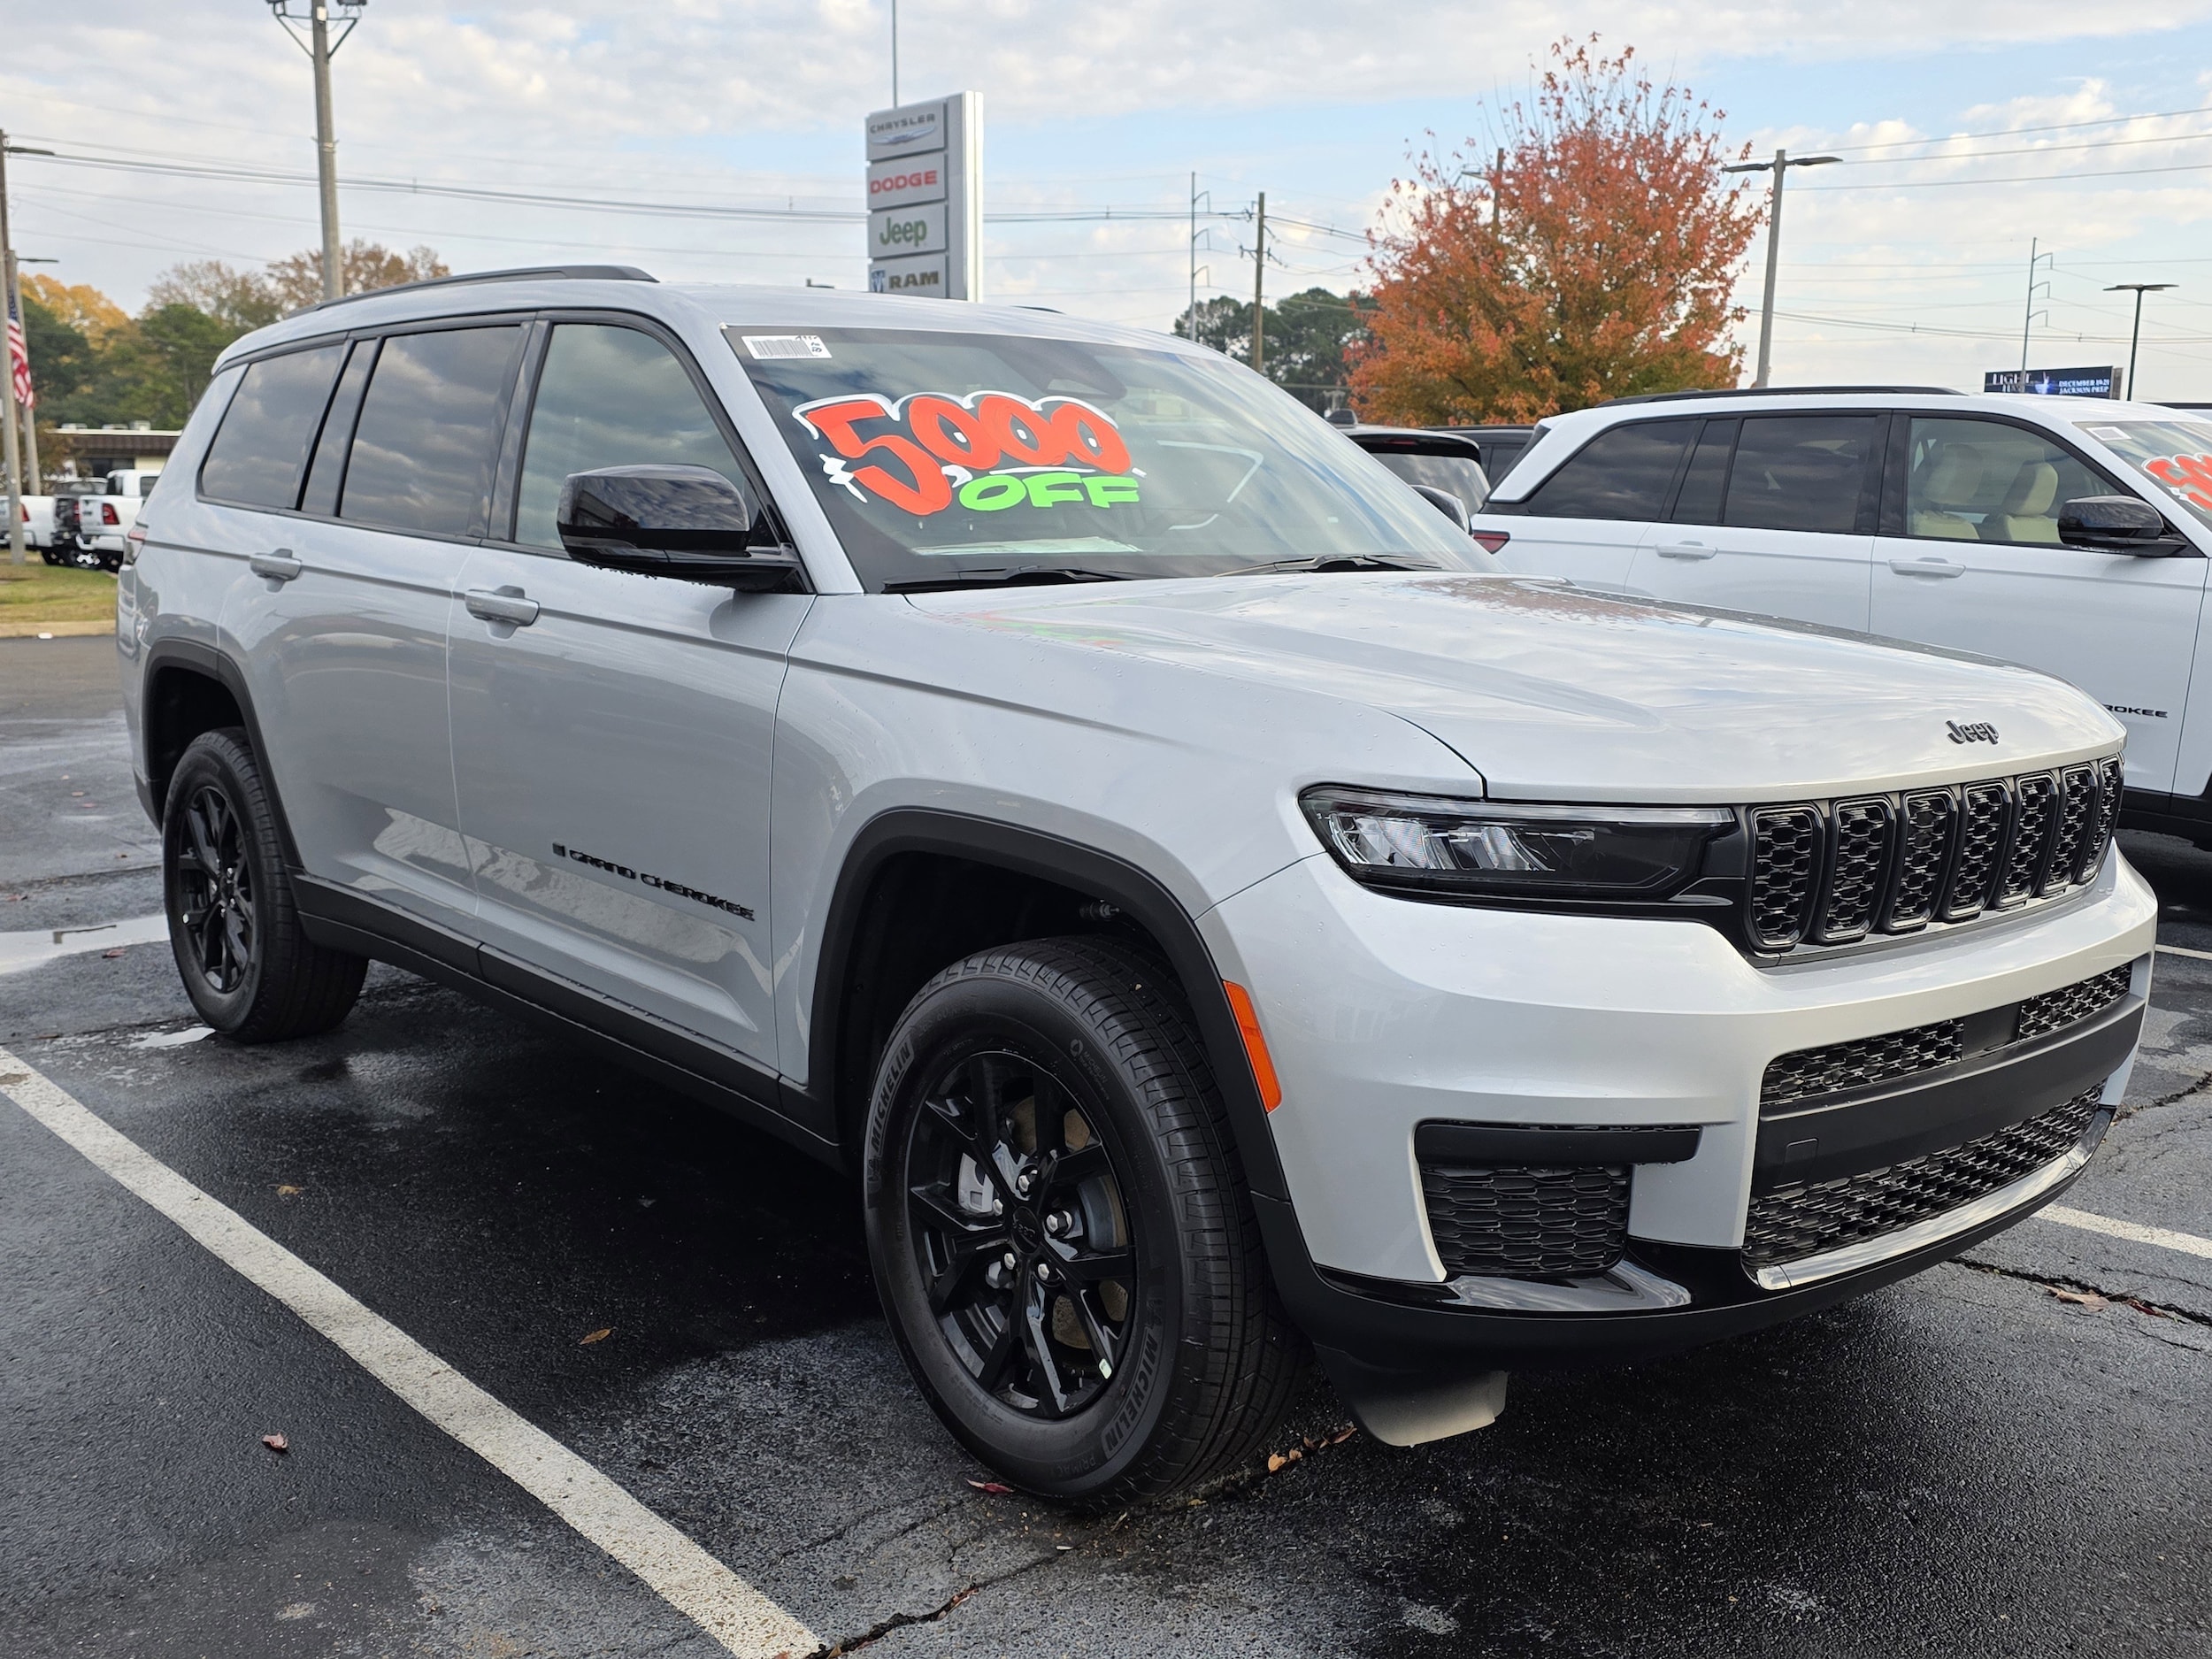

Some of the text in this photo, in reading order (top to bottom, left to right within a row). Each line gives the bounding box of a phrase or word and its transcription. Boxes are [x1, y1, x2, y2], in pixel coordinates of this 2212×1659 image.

[870, 113, 935, 134] CHRYSLER
[870, 170, 937, 195] DODGE
[879, 217, 926, 247] Jeep
[888, 271, 940, 289] RAM
[959, 472, 1141, 511] OFF
[1946, 720, 2000, 745] Jeep
[569, 849, 755, 921] GRAND CHEROKEE
[870, 1041, 911, 1152] MICHELIN
[1105, 1333, 1158, 1453] MICHELIN
